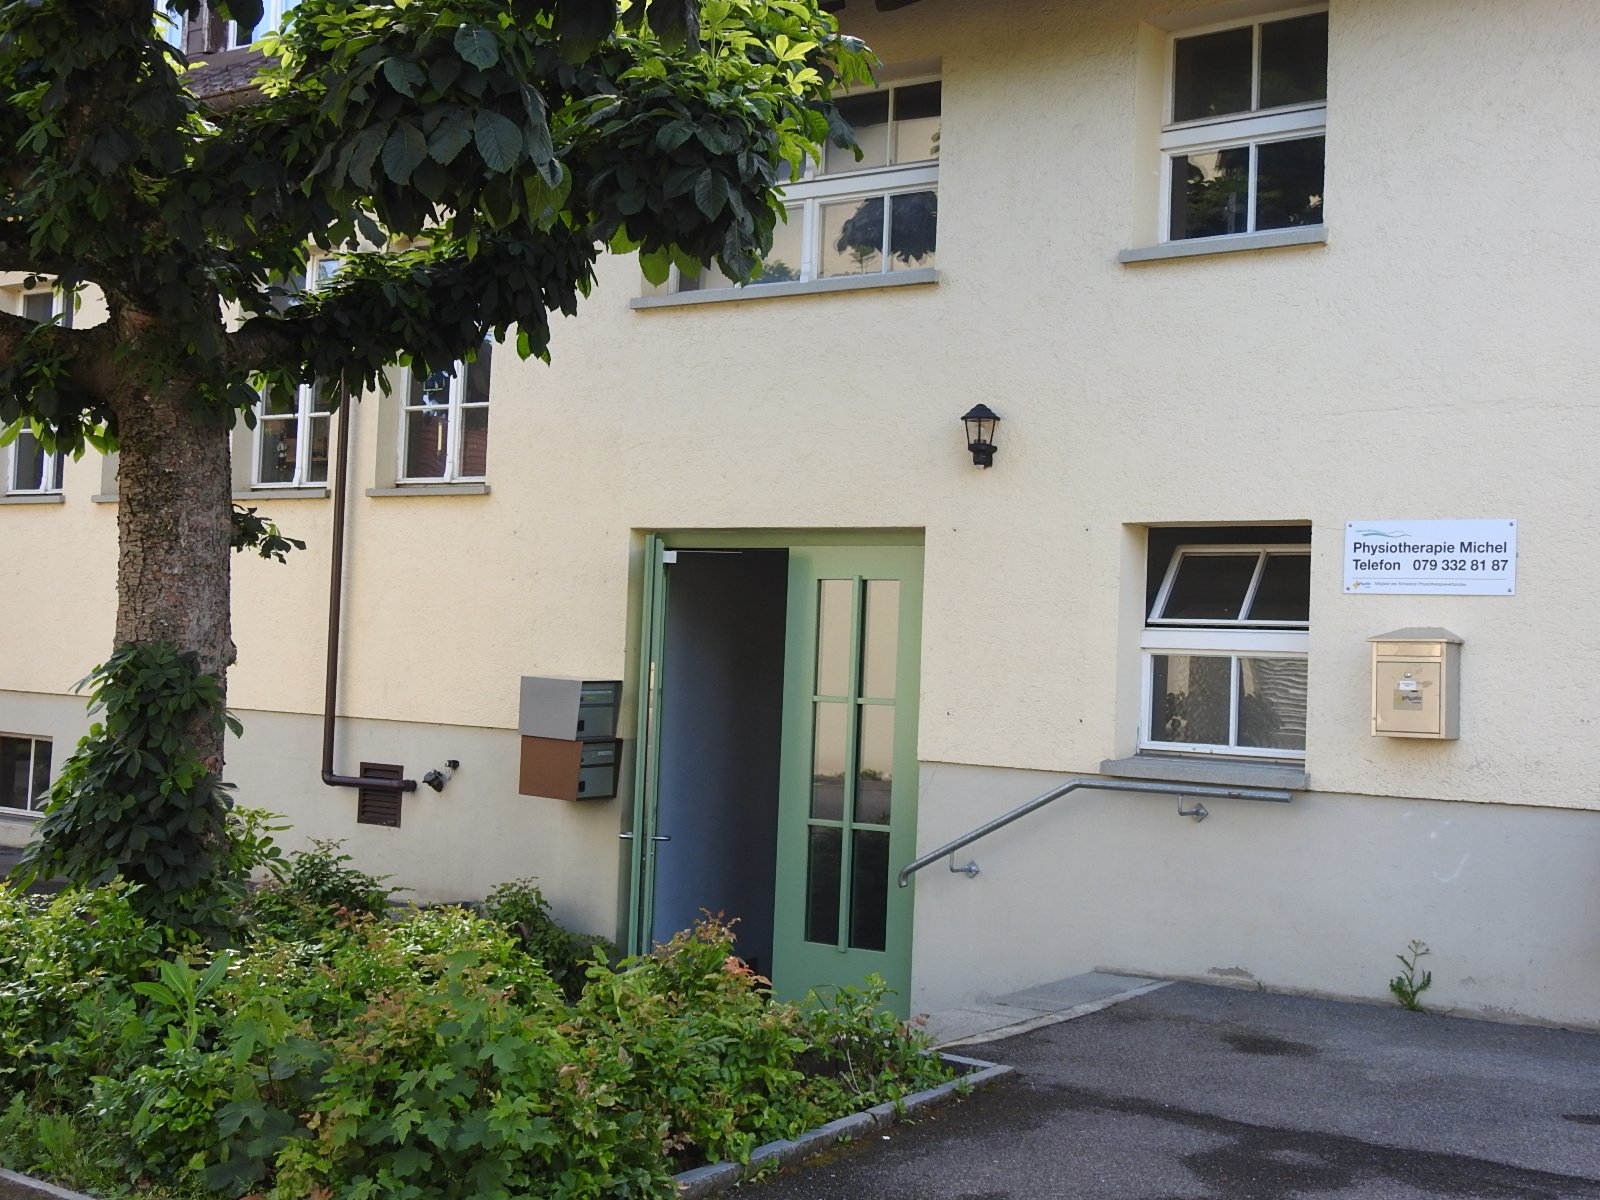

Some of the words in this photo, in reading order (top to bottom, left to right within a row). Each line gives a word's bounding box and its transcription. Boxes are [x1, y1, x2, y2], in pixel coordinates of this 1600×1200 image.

[1353, 541, 1455, 556] Physiotherapie
[1459, 541, 1507, 554] Michel
[1353, 559, 1401, 571] Telefon
[1413, 559, 1438, 571] 079
[1441, 559, 1466, 571] 332
[1470, 559, 1486, 571] 81
[1491, 559, 1509, 571] 87
